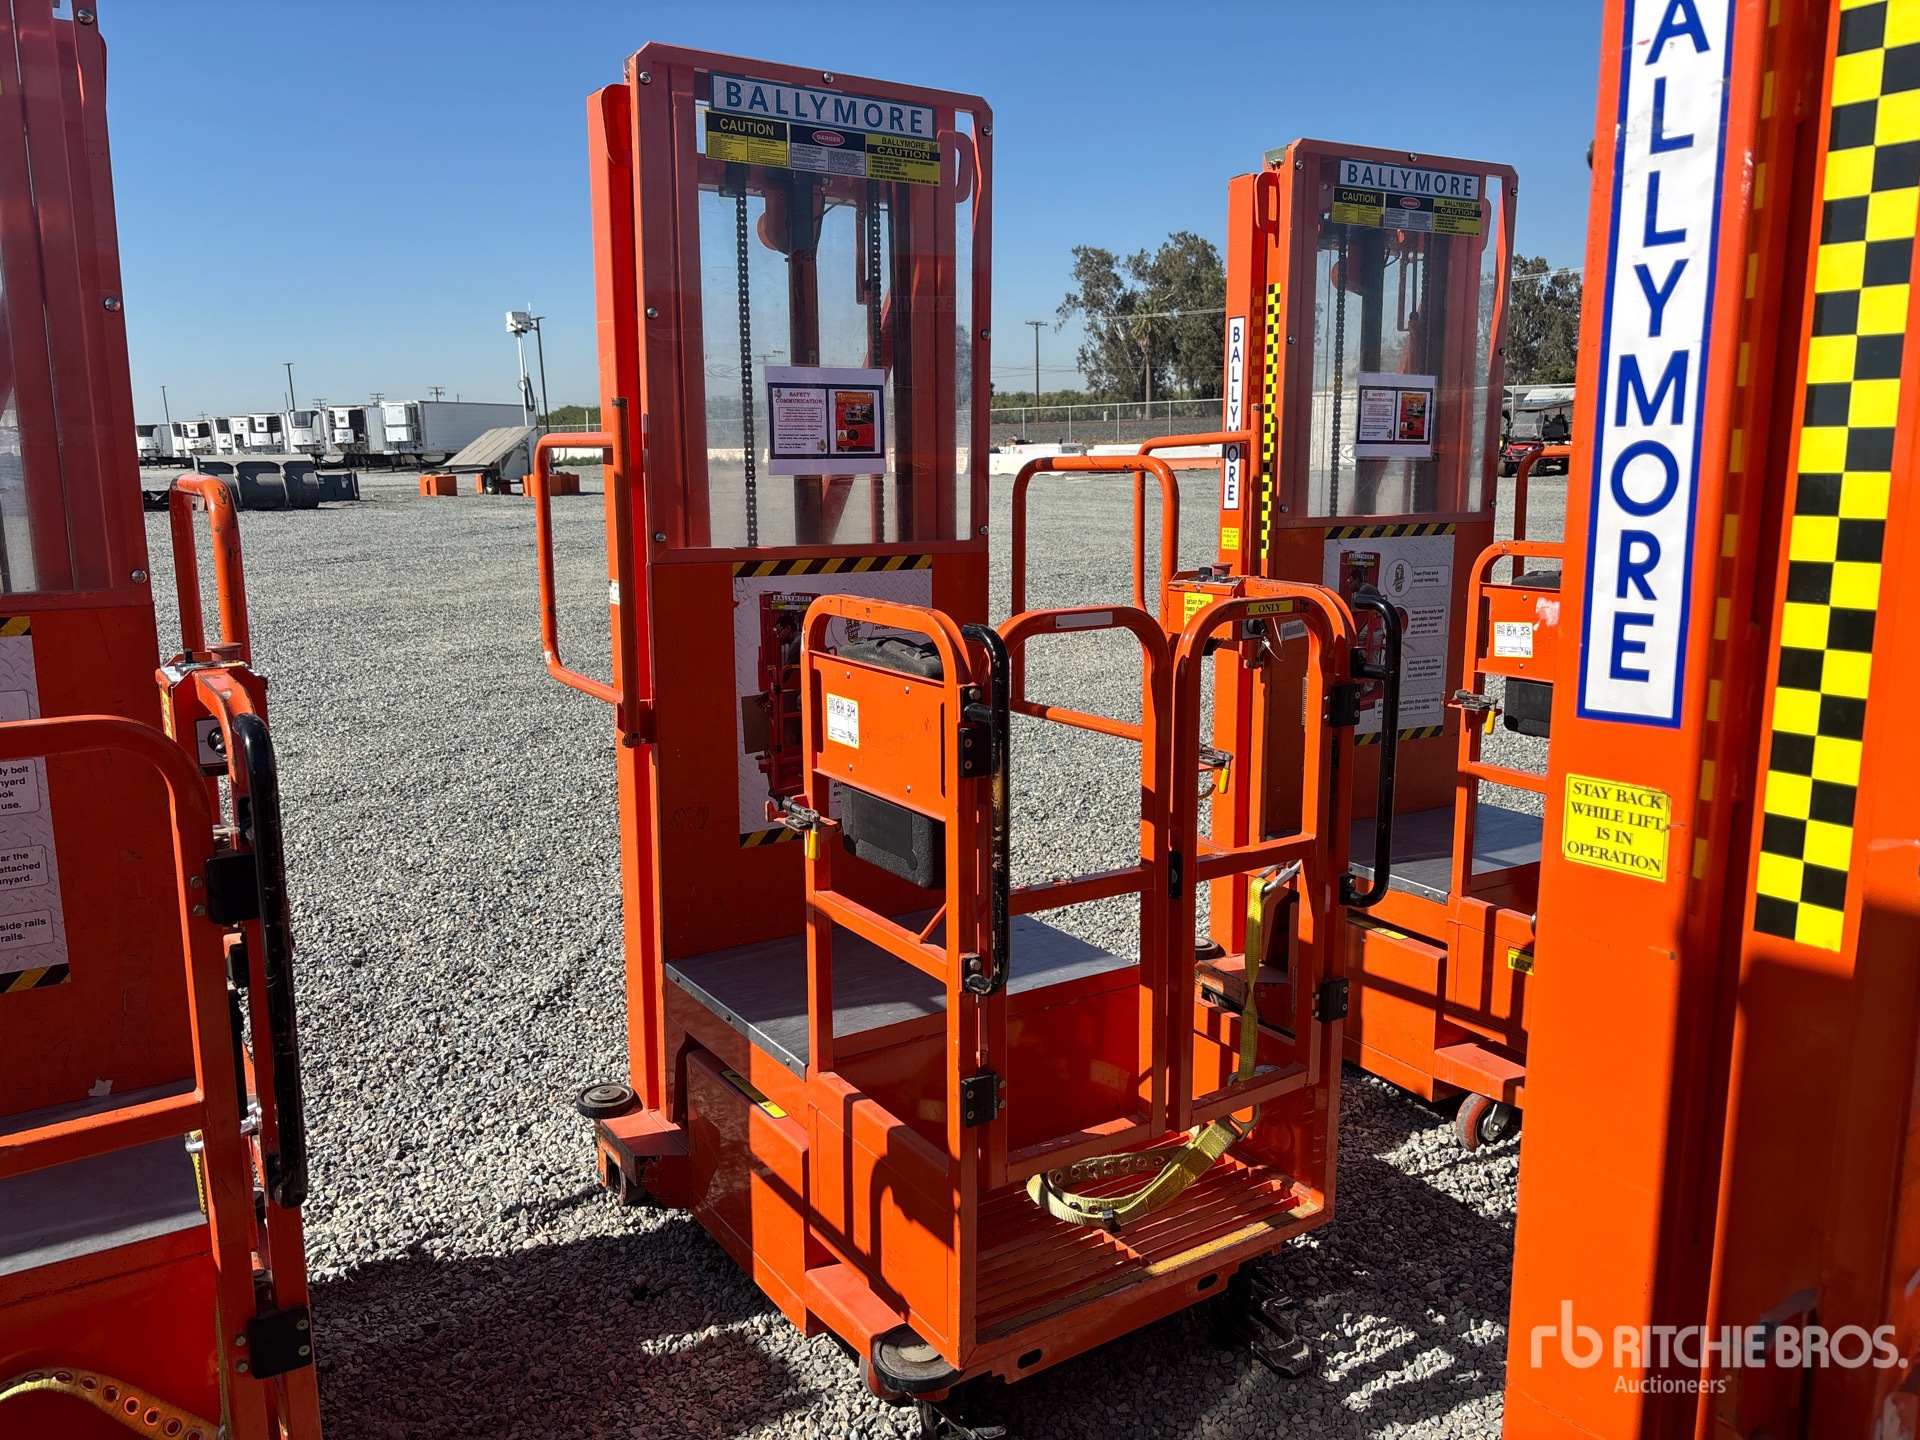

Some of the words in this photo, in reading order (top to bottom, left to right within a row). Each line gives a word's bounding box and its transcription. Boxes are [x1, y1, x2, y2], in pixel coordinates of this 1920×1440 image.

[726, 81, 922, 133] BALLYMORE
[720, 118, 774, 136] CAUTION
[816, 135, 841, 143] DANGER
[882, 138, 925, 149] BALLYMORE
[877, 147, 930, 159] CAUTION
[1347, 164, 1472, 196] BALLYMORE
[1342, 192, 1376, 204] CAUTION
[1444, 200, 1472, 208] BALLYMORE
[1441, 208, 1475, 216] CAUTION
[1228, 326, 1241, 501] BALLYORE
[1258, 603, 1281, 613] ONLY
[10, 766, 29, 774] belt
[1573, 782, 1611, 800] STAY
[1616, 789, 1662, 809] BACK
[1571, 801, 1623, 823] WHILE
[1627, 812, 1664, 831] LIFT
[1596, 826, 1610, 841] IS
[1614, 830, 1634, 845] IN
[13, 852, 29, 861] the
[1567, 840, 1661, 872] OPERATION
[0, 861, 40, 873] attached
[0, 921, 22, 931] side
[24, 918, 46, 928] rails
[1, 933, 25, 943] rails.
